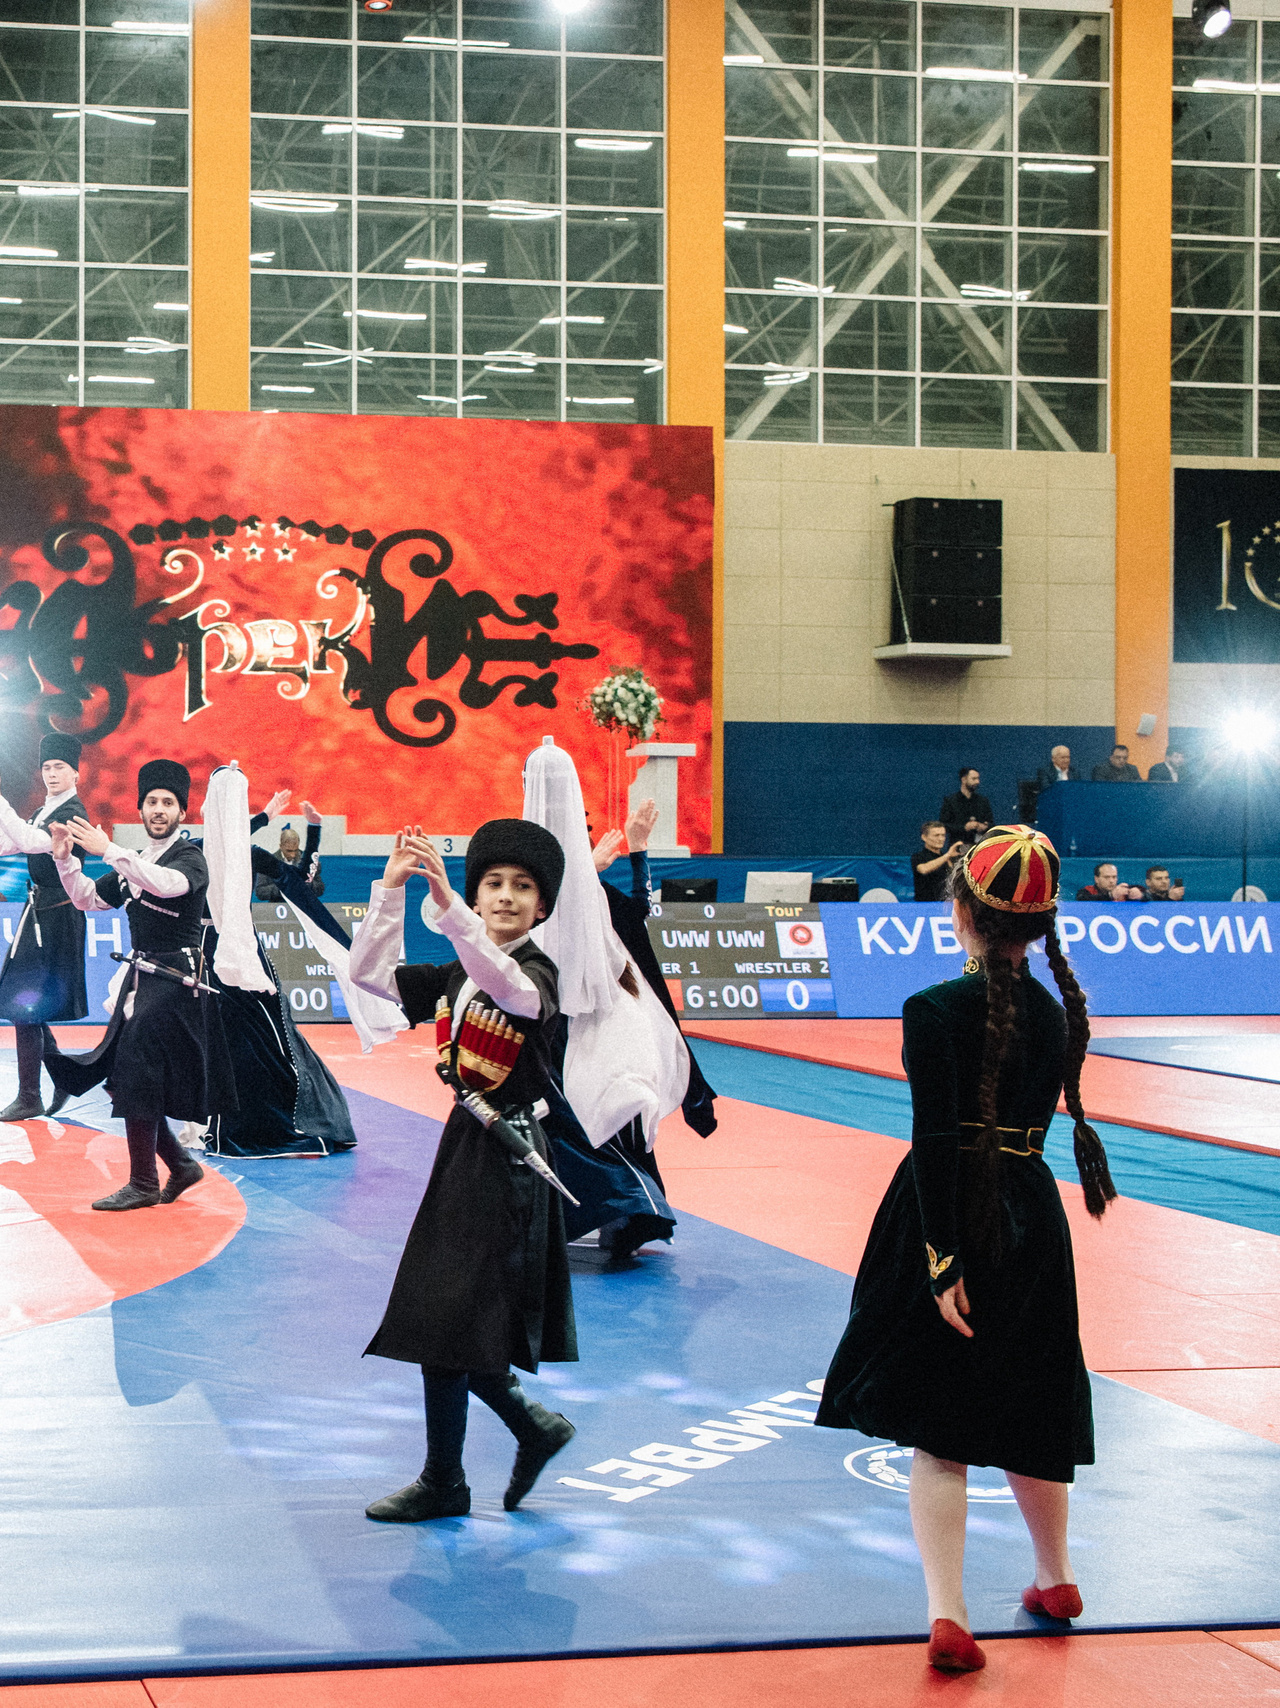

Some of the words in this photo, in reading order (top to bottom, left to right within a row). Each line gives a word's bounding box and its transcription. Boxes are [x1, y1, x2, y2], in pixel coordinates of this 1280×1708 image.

[443, 838, 453, 853] 3
[275, 904, 288, 919] 0
[703, 904, 716, 919] 0
[765, 905, 803, 917] Tour
[661, 930, 710, 948] UWW
[716, 930, 765, 948] UWW
[1057, 914, 1273, 955] РОССИИ
[689, 961, 701, 974] 1
[734, 962, 812, 974] WRESTLER
[819, 960, 829, 974] 2
[686, 984, 759, 1009] 6:00
[786, 980, 810, 1011] 0
[556, 1378, 825, 1503] LIMPBET
